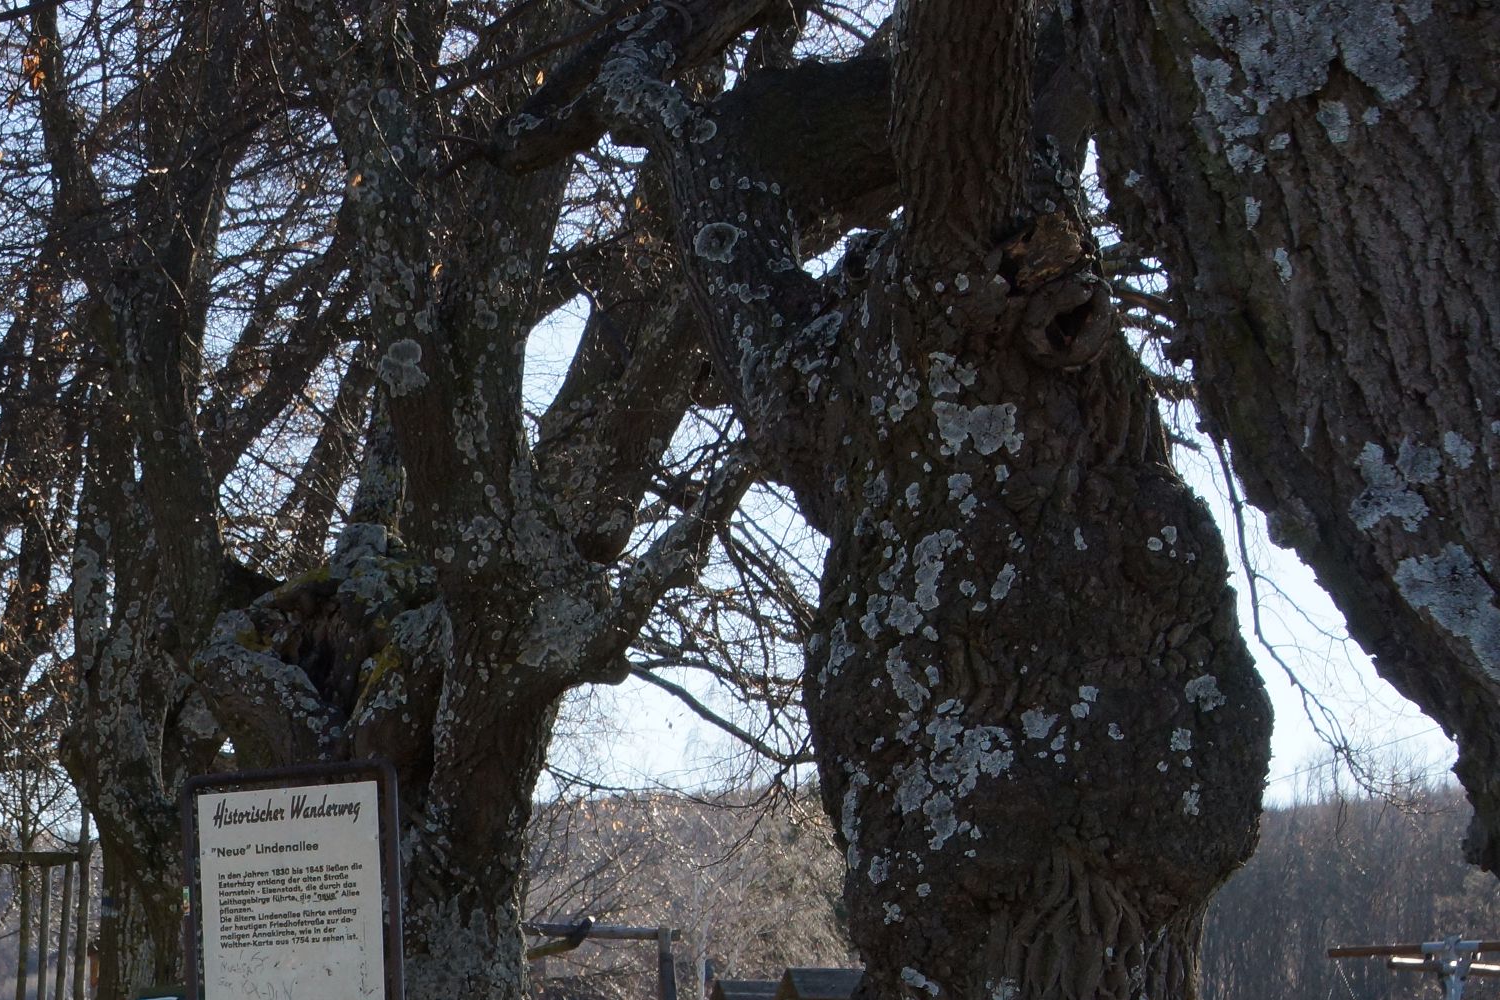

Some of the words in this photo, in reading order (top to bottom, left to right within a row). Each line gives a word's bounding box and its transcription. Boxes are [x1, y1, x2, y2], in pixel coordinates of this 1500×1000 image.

[213, 799, 285, 829] Historischer
[290, 794, 360, 823] Wanderweg
[256, 841, 318, 854] Lindenallee
[243, 871, 269, 881] Jahren
[306, 865, 323, 873] 1845
[257, 879, 285, 887] entlang
[219, 897, 270, 906] Leithagebirge
[272, 895, 297, 903] führte,
[219, 907, 253, 916] pflanzen.
[258, 912, 300, 920] Lindenallee
[328, 908, 357, 916] entlang
[235, 922, 267, 932] heutigen
[270, 919, 324, 928] Friedhofstraße
[220, 932, 250, 941] maligen
[253, 929, 297, 938] Annakirche,
[221, 940, 273, 949] Walther-Karte
[292, 937, 309, 945] 1754
